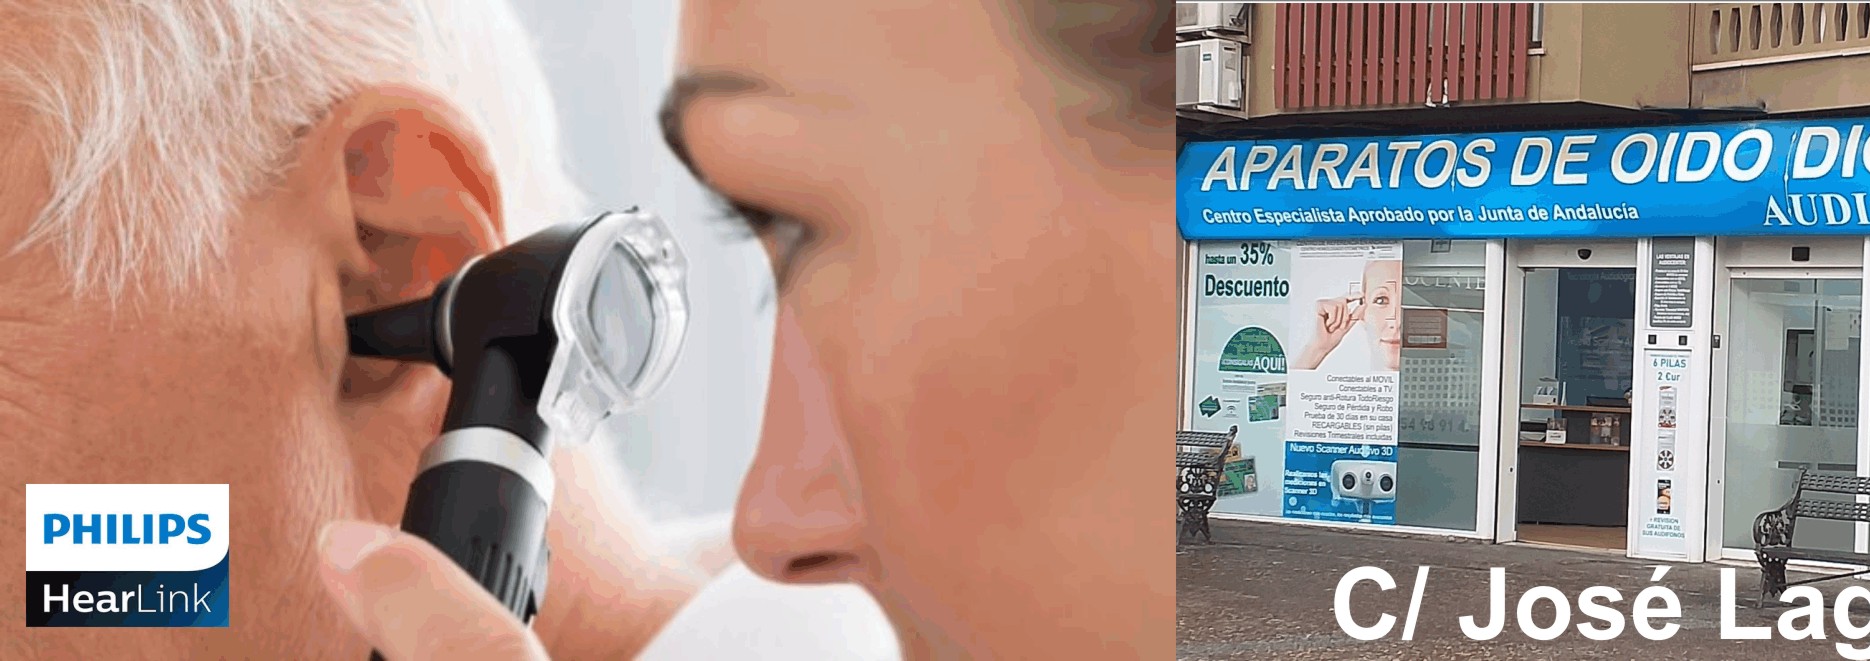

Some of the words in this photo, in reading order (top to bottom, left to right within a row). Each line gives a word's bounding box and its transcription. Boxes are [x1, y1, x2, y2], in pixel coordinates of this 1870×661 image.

[1201, 137, 1495, 192] APARATOS
[1509, 134, 1598, 187] DE
[1610, 127, 1774, 185] OIDO
[1202, 208, 1251, 224] Centro
[1254, 208, 1345, 226] Especialista
[1348, 206, 1424, 225] Aprobado
[1428, 208, 1454, 224] por
[1457, 205, 1474, 222] la
[1478, 205, 1525, 222] Junta
[1528, 204, 1548, 220] de
[1552, 203, 1639, 221] Andalucía
[1205, 253, 1225, 264] hasta
[1227, 256, 1236, 264] un
[1240, 242, 1274, 265] 35%
[1205, 274, 1290, 297] Descuento
[1253, 354, 1285, 373] AQUÍ!
[1653, 358, 1658, 367] 6
[1660, 358, 1687, 368] PILAS
[1327, 375, 1364, 383] Conectables
[1658, 371, 1663, 380] 2
[1300, 393, 1322, 402] Seguro
[1315, 403, 1336, 411] Seguro
[1376, 404, 1393, 412] Robo
[1336, 412, 1345, 420] 30
[1312, 421, 1362, 430] RECARGABLES
[1294, 430, 1326, 438] Revisiones
[1327, 431, 1364, 440] Trimestrales
[1290, 443, 1314, 453] Nuevo
[1316, 444, 1347, 454] Scanner
[1381, 447, 1393, 456] 3D
